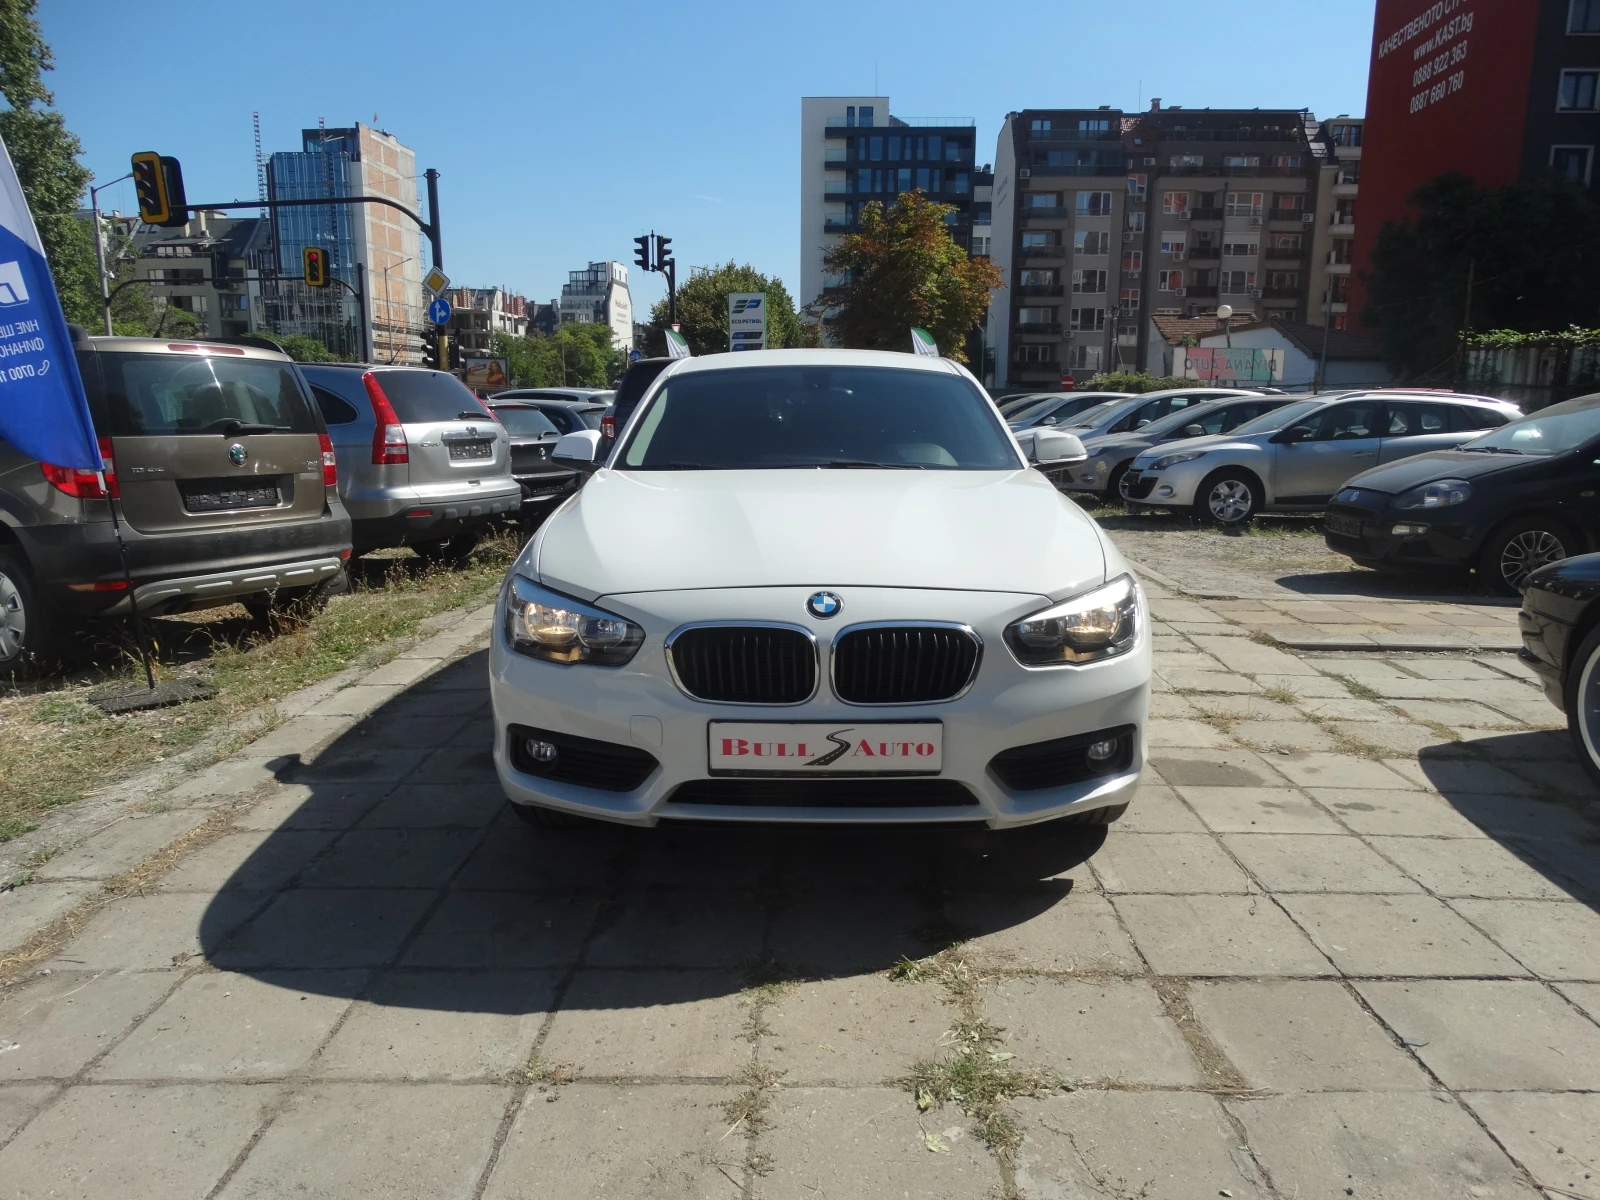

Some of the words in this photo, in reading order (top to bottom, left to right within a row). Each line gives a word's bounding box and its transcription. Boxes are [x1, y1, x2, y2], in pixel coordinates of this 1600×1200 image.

[1378, 2, 1443, 59] КАЧЕСТВЕНОТО
[1413, 12, 1474, 61] www.KAST.bg
[1413, 61, 1432, 87] 0888
[1433, 51, 1449, 75] 922
[1450, 40, 1467, 65] 363
[1410, 89, 1429, 114] 0887
[1430, 81, 1446, 104] 660
[1448, 70, 1464, 95] 760
